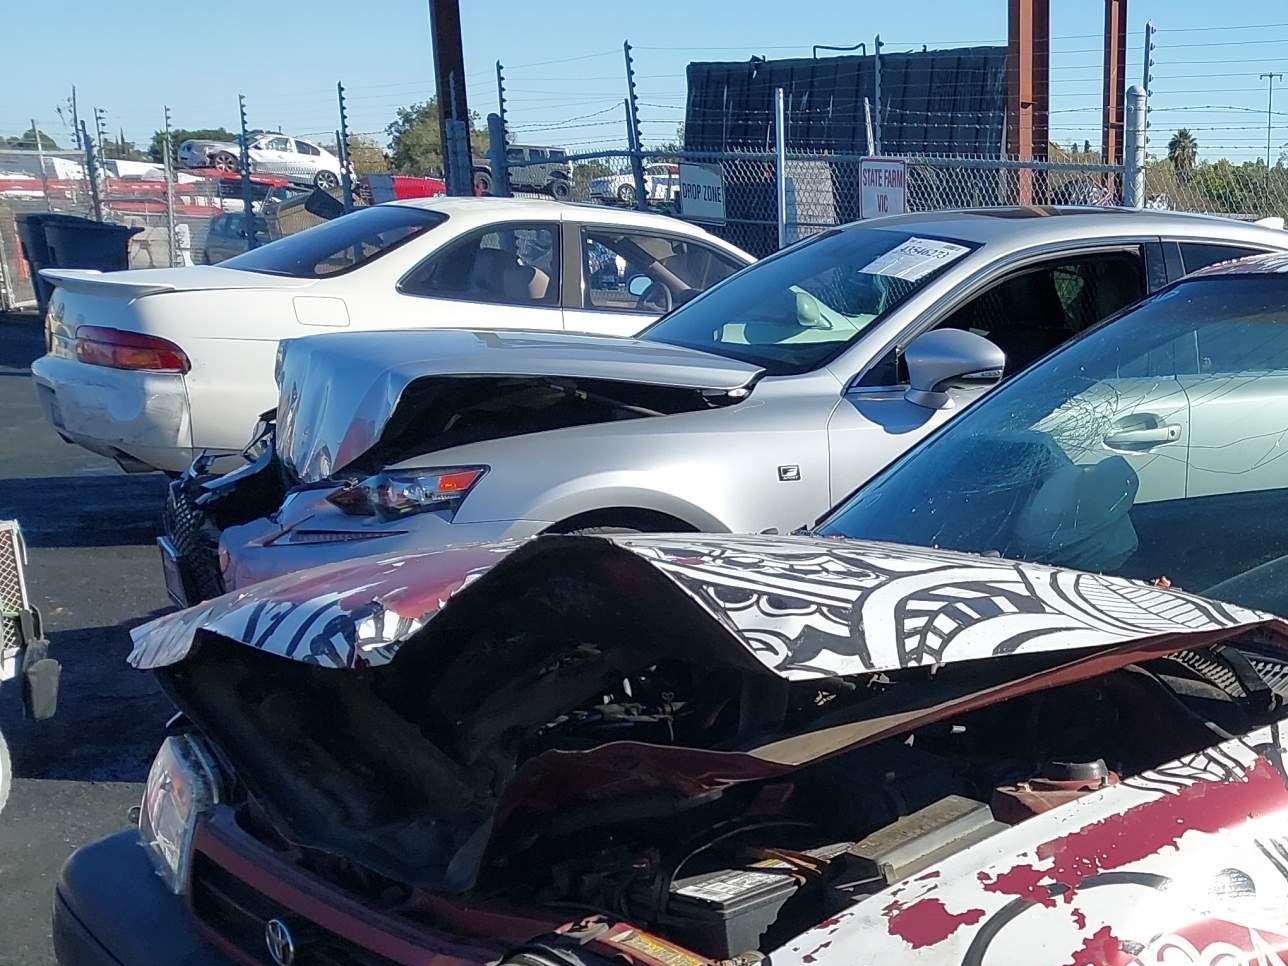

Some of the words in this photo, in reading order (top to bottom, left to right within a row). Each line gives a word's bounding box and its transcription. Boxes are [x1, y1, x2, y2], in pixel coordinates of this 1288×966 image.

[863, 168, 881, 186] STATE
[885, 170, 903, 188] FARM
[682, 183, 701, 199] DROP
[703, 185, 721, 203] ZONE
[877, 195, 889, 213] VIC
